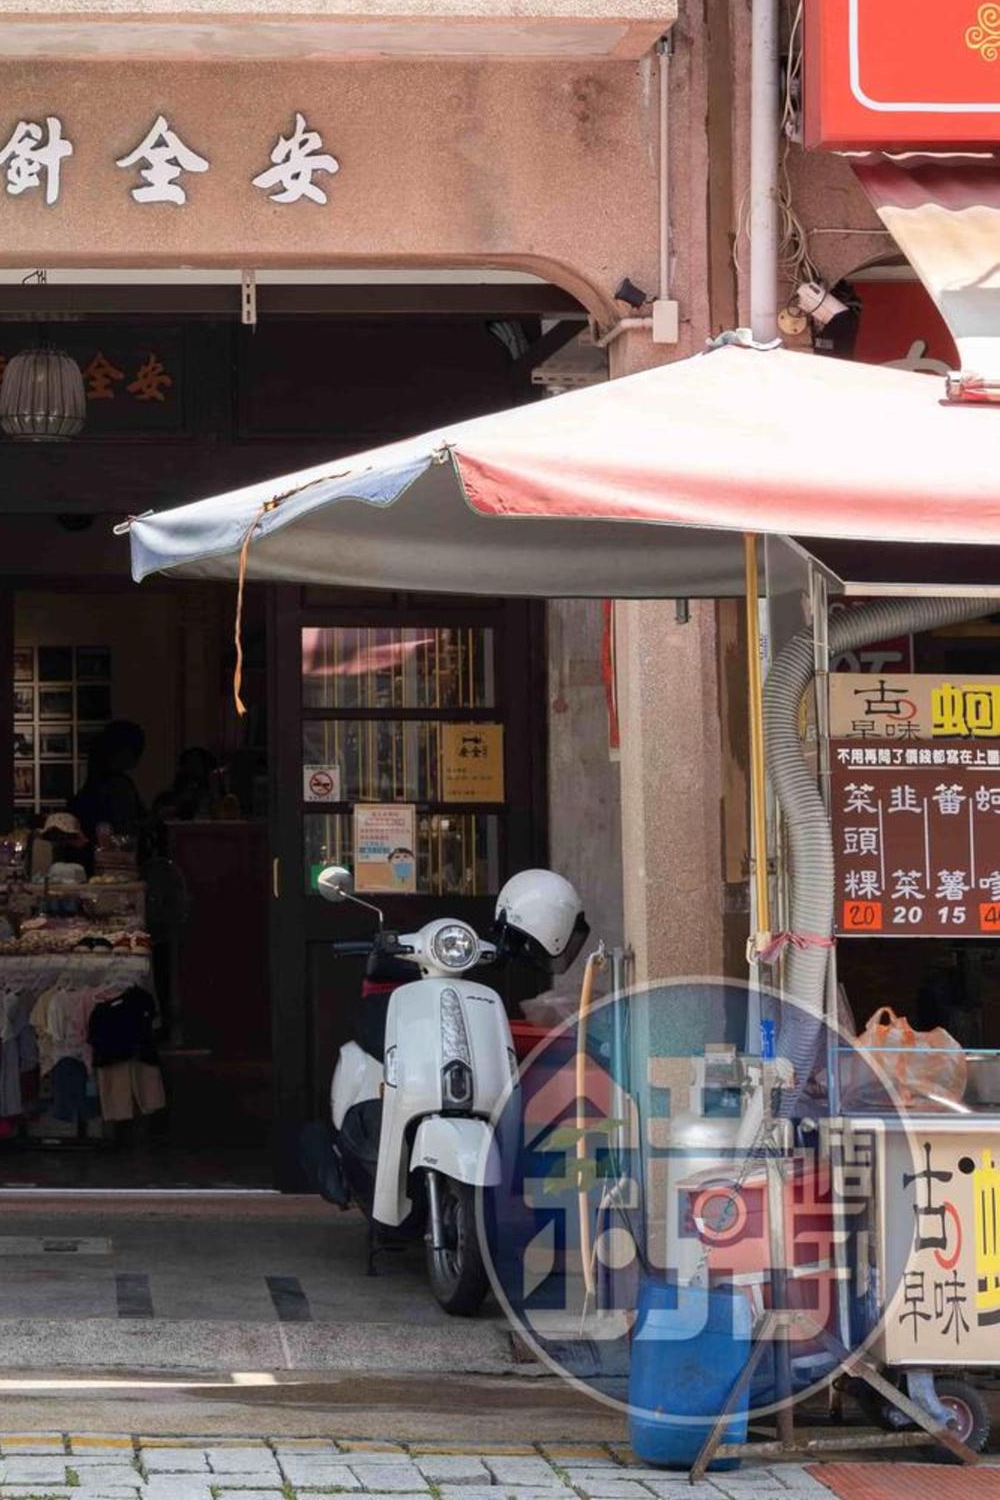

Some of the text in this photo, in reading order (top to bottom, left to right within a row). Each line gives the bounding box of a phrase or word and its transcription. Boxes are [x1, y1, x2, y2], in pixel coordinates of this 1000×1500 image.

[843, 783, 881, 900] 菜頭粿
[888, 785, 926, 900] 韭菜
[893, 906, 923, 924] 20
[937, 906, 967, 924] 15
[984, 906, 1000, 925] 4
[902, 1141, 953, 1252] 古
